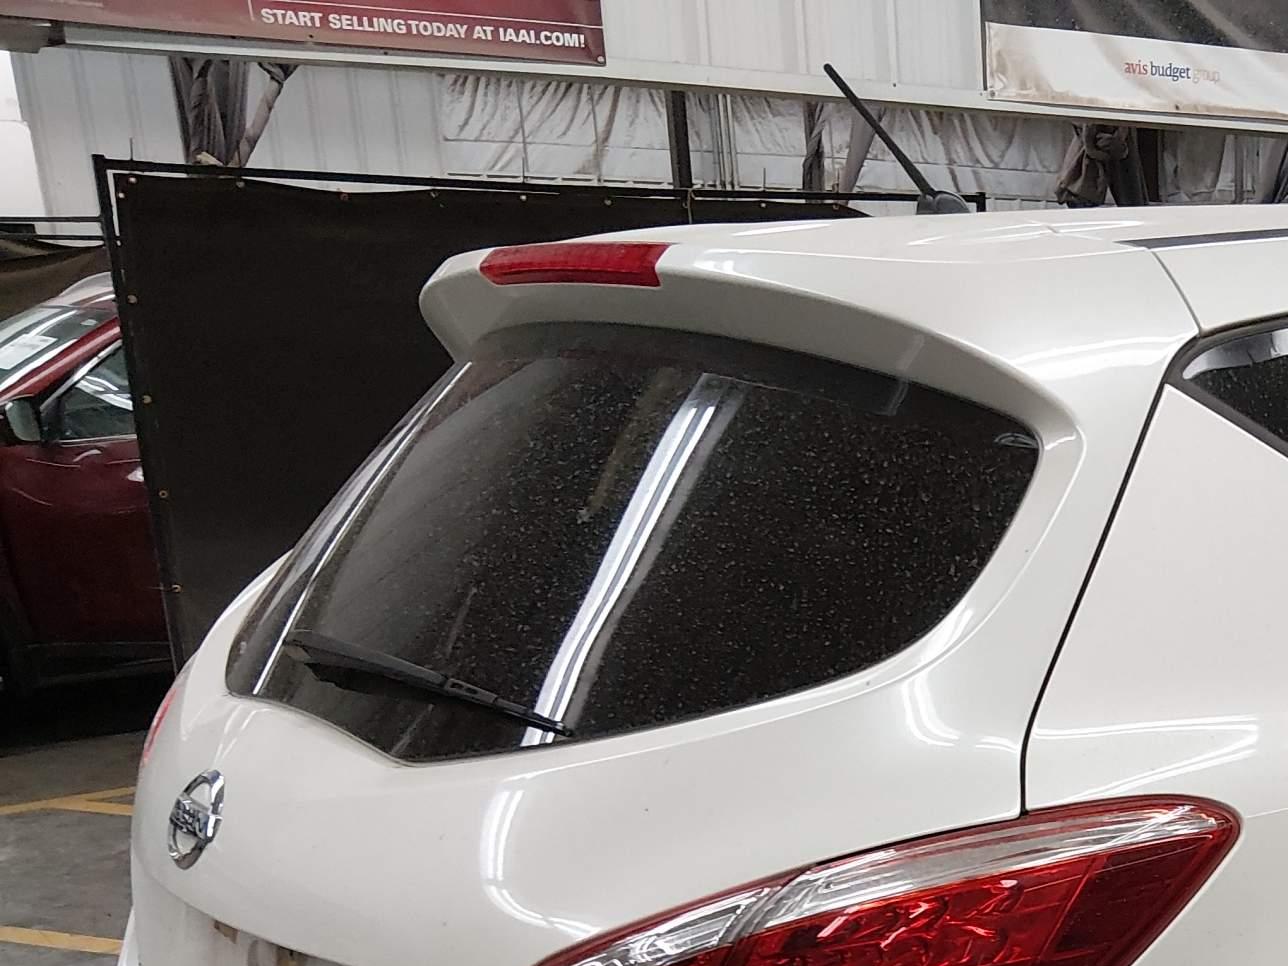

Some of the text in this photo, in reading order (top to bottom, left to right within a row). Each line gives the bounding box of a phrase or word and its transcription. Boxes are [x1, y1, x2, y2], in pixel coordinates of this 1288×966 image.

[260, 8, 586, 48] START SELLING TODAY AT IAAI.COM!
[1124, 60, 1149, 76] avis
[1150, 61, 1191, 81] budget
